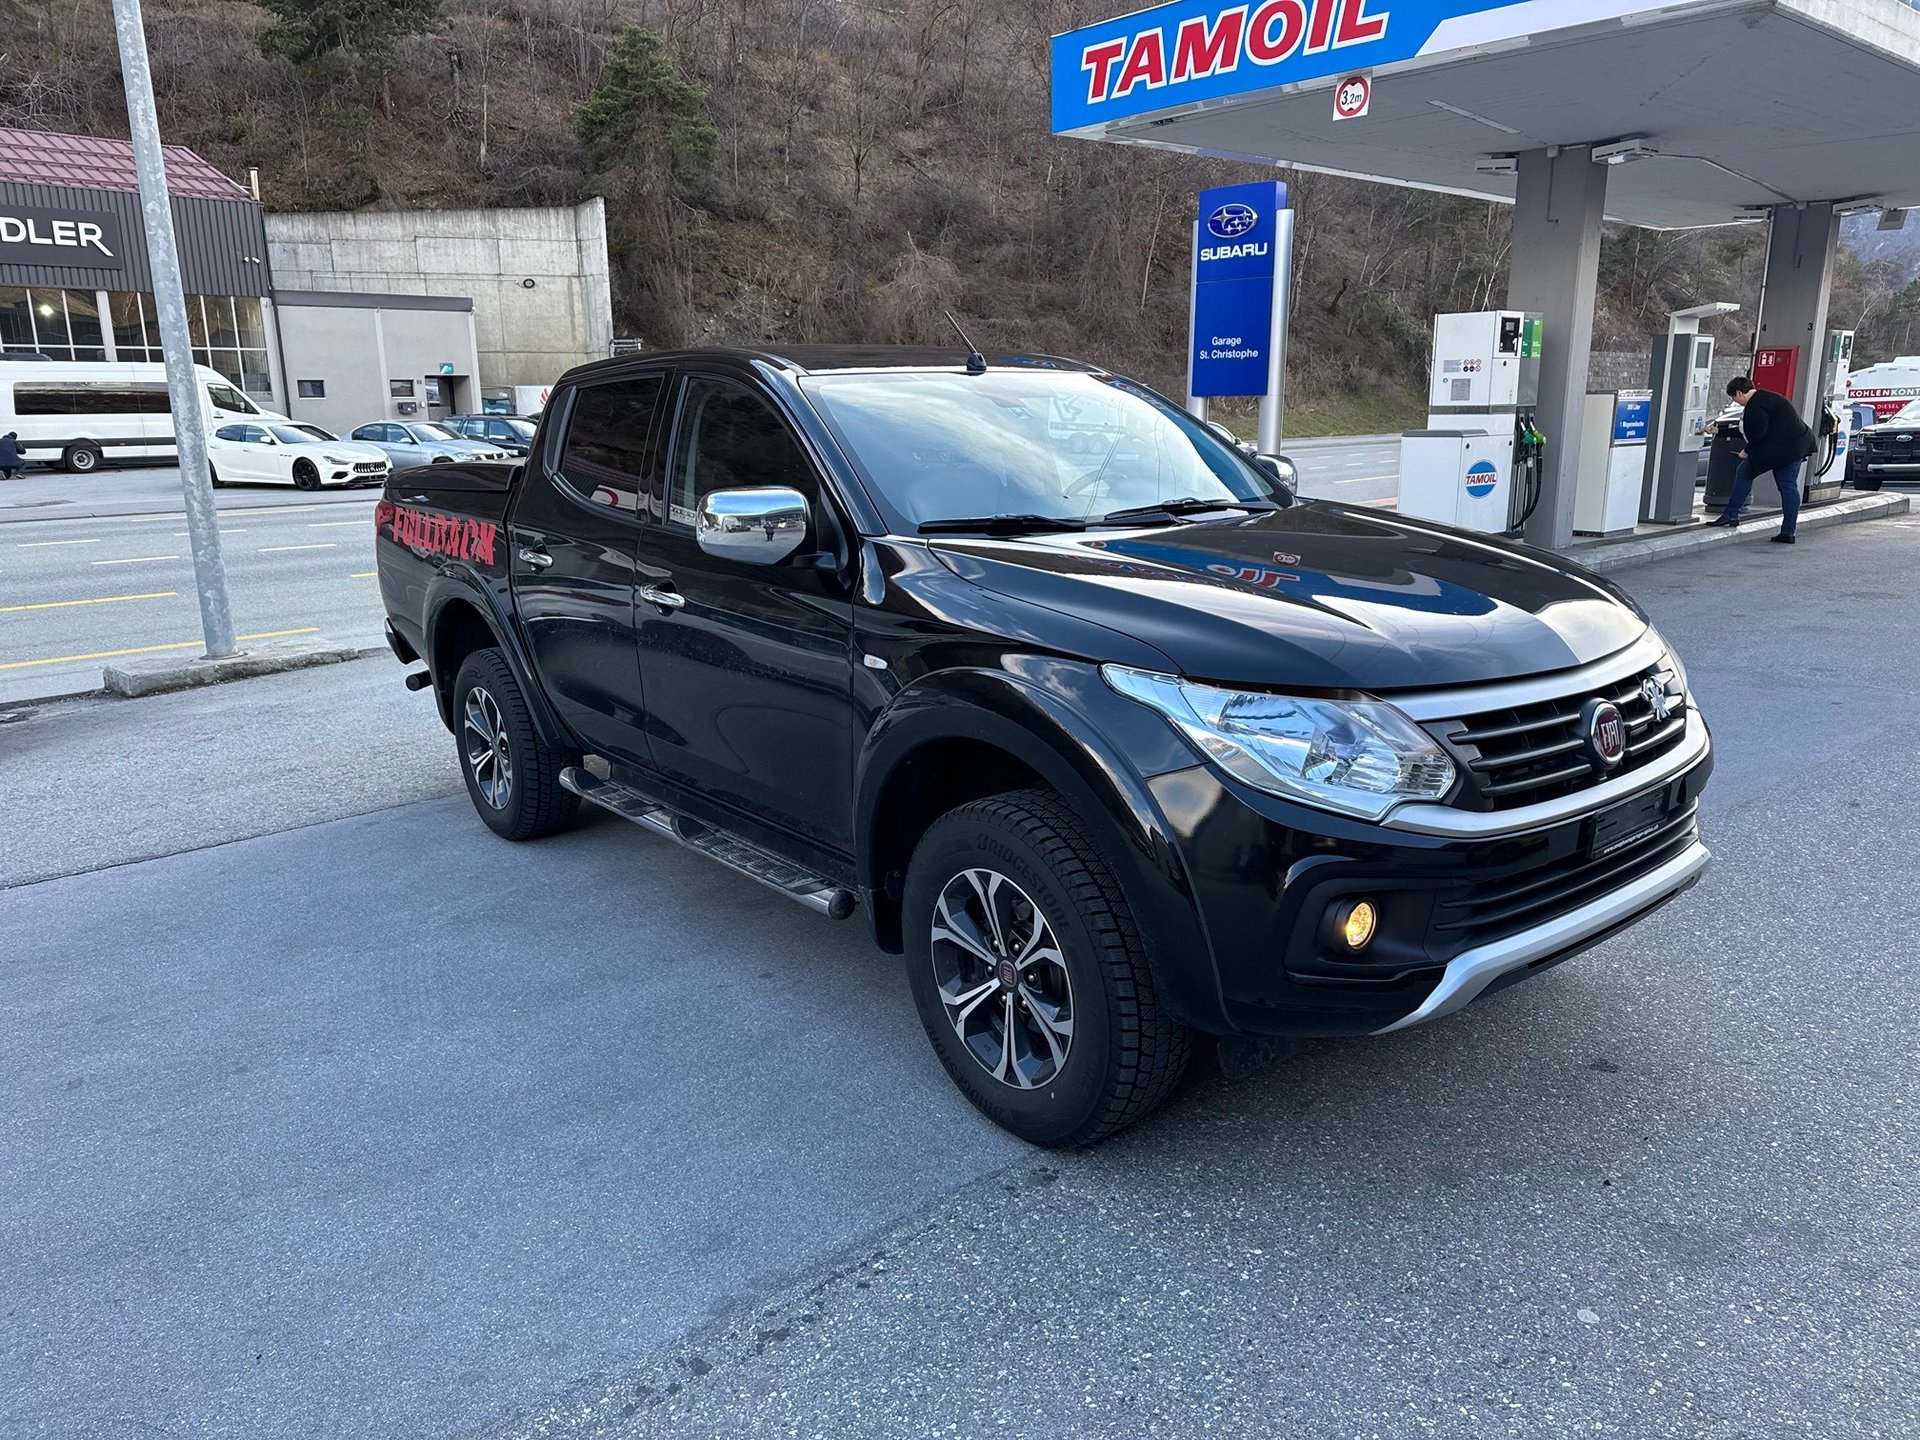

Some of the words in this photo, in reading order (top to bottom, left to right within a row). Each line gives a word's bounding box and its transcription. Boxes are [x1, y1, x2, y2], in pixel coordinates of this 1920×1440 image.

[1081, 0, 1389, 104] TAMOIL
[0, 216, 114, 257] DLER
[1200, 242, 1268, 261] SUBARU
[1761, 324, 1767, 332] 4
[1807, 322, 1813, 331] 3
[1211, 336, 1242, 347] Garage
[1199, 350, 1210, 360] St.
[1211, 348, 1259, 360] Christophe
[1466, 473, 1497, 485] TAMOIL
[1600, 720, 1620, 749] FIAT
[976, 832, 1073, 935] BRIDGESTONE
